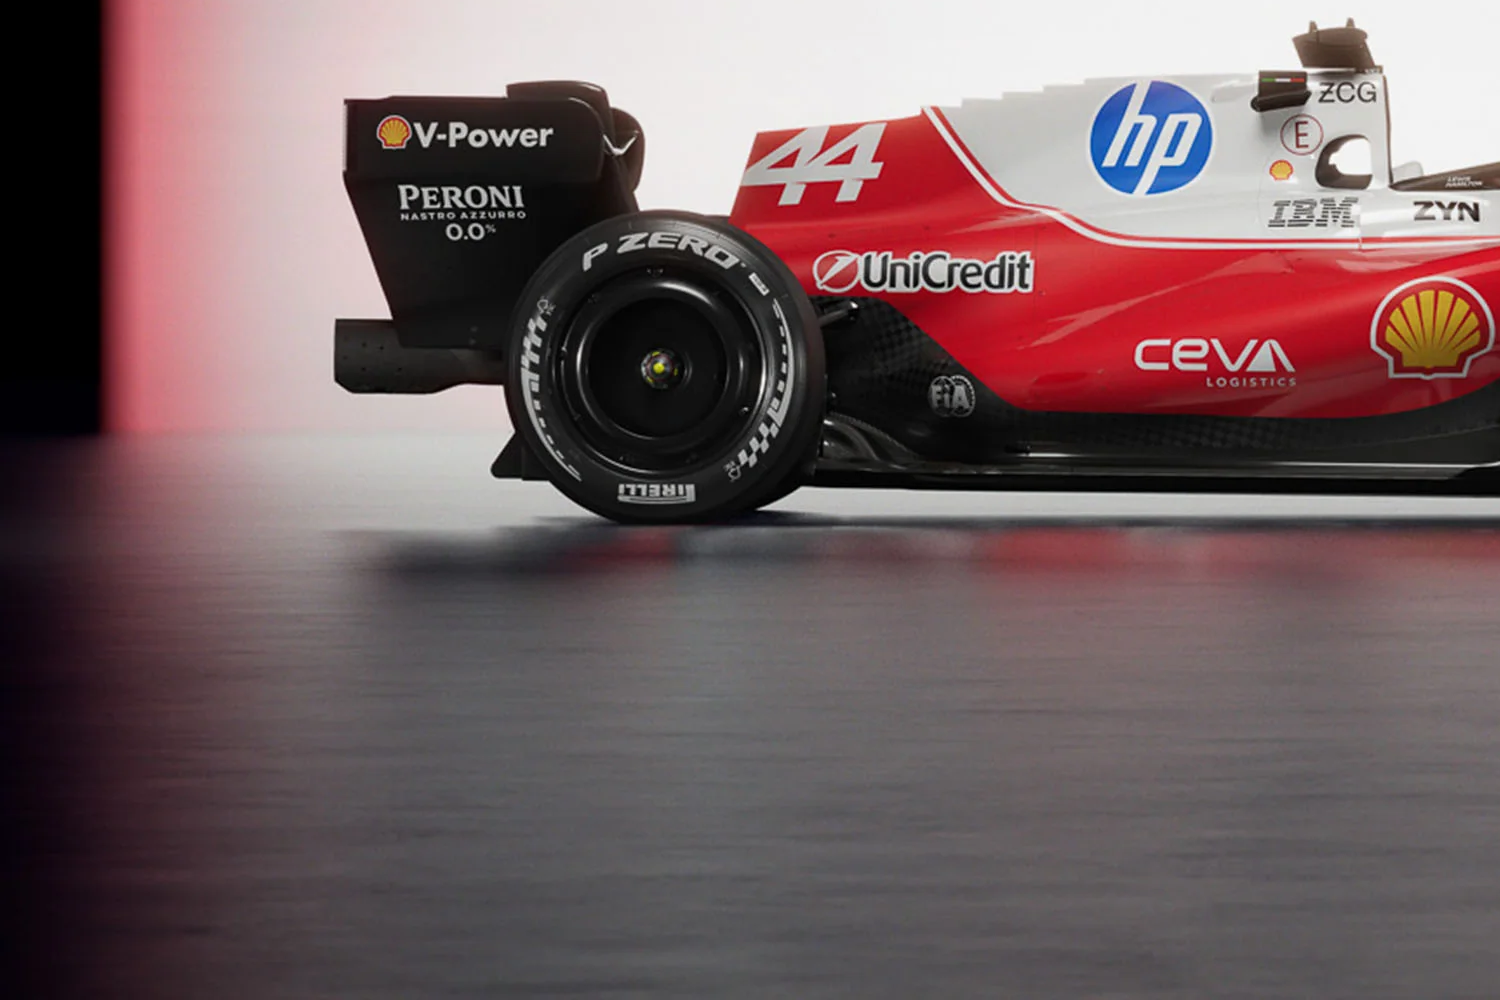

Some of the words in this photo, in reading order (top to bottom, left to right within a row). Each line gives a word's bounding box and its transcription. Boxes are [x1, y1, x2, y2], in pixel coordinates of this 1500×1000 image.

[1318, 82, 1377, 103] ZCG
[413, 121, 554, 148] V-Power
[1101, 81, 1202, 194] hp
[1294, 120, 1309, 149] E
[741, 121, 888, 206] 44
[397, 184, 525, 210] PERONI
[400, 211, 456, 220] NASTRO
[460, 211, 527, 220] AZZURRO
[1267, 196, 1359, 228] IBM
[1413, 200, 1480, 223] ZYN
[445, 222, 497, 241] 0.0%
[582, 242, 609, 271] P
[616, 232, 740, 270] ZERO
[862, 252, 1034, 291] UniCredit
[1206, 376, 1297, 387] LOGISTICS
[617, 482, 696, 504] PIRELLI
